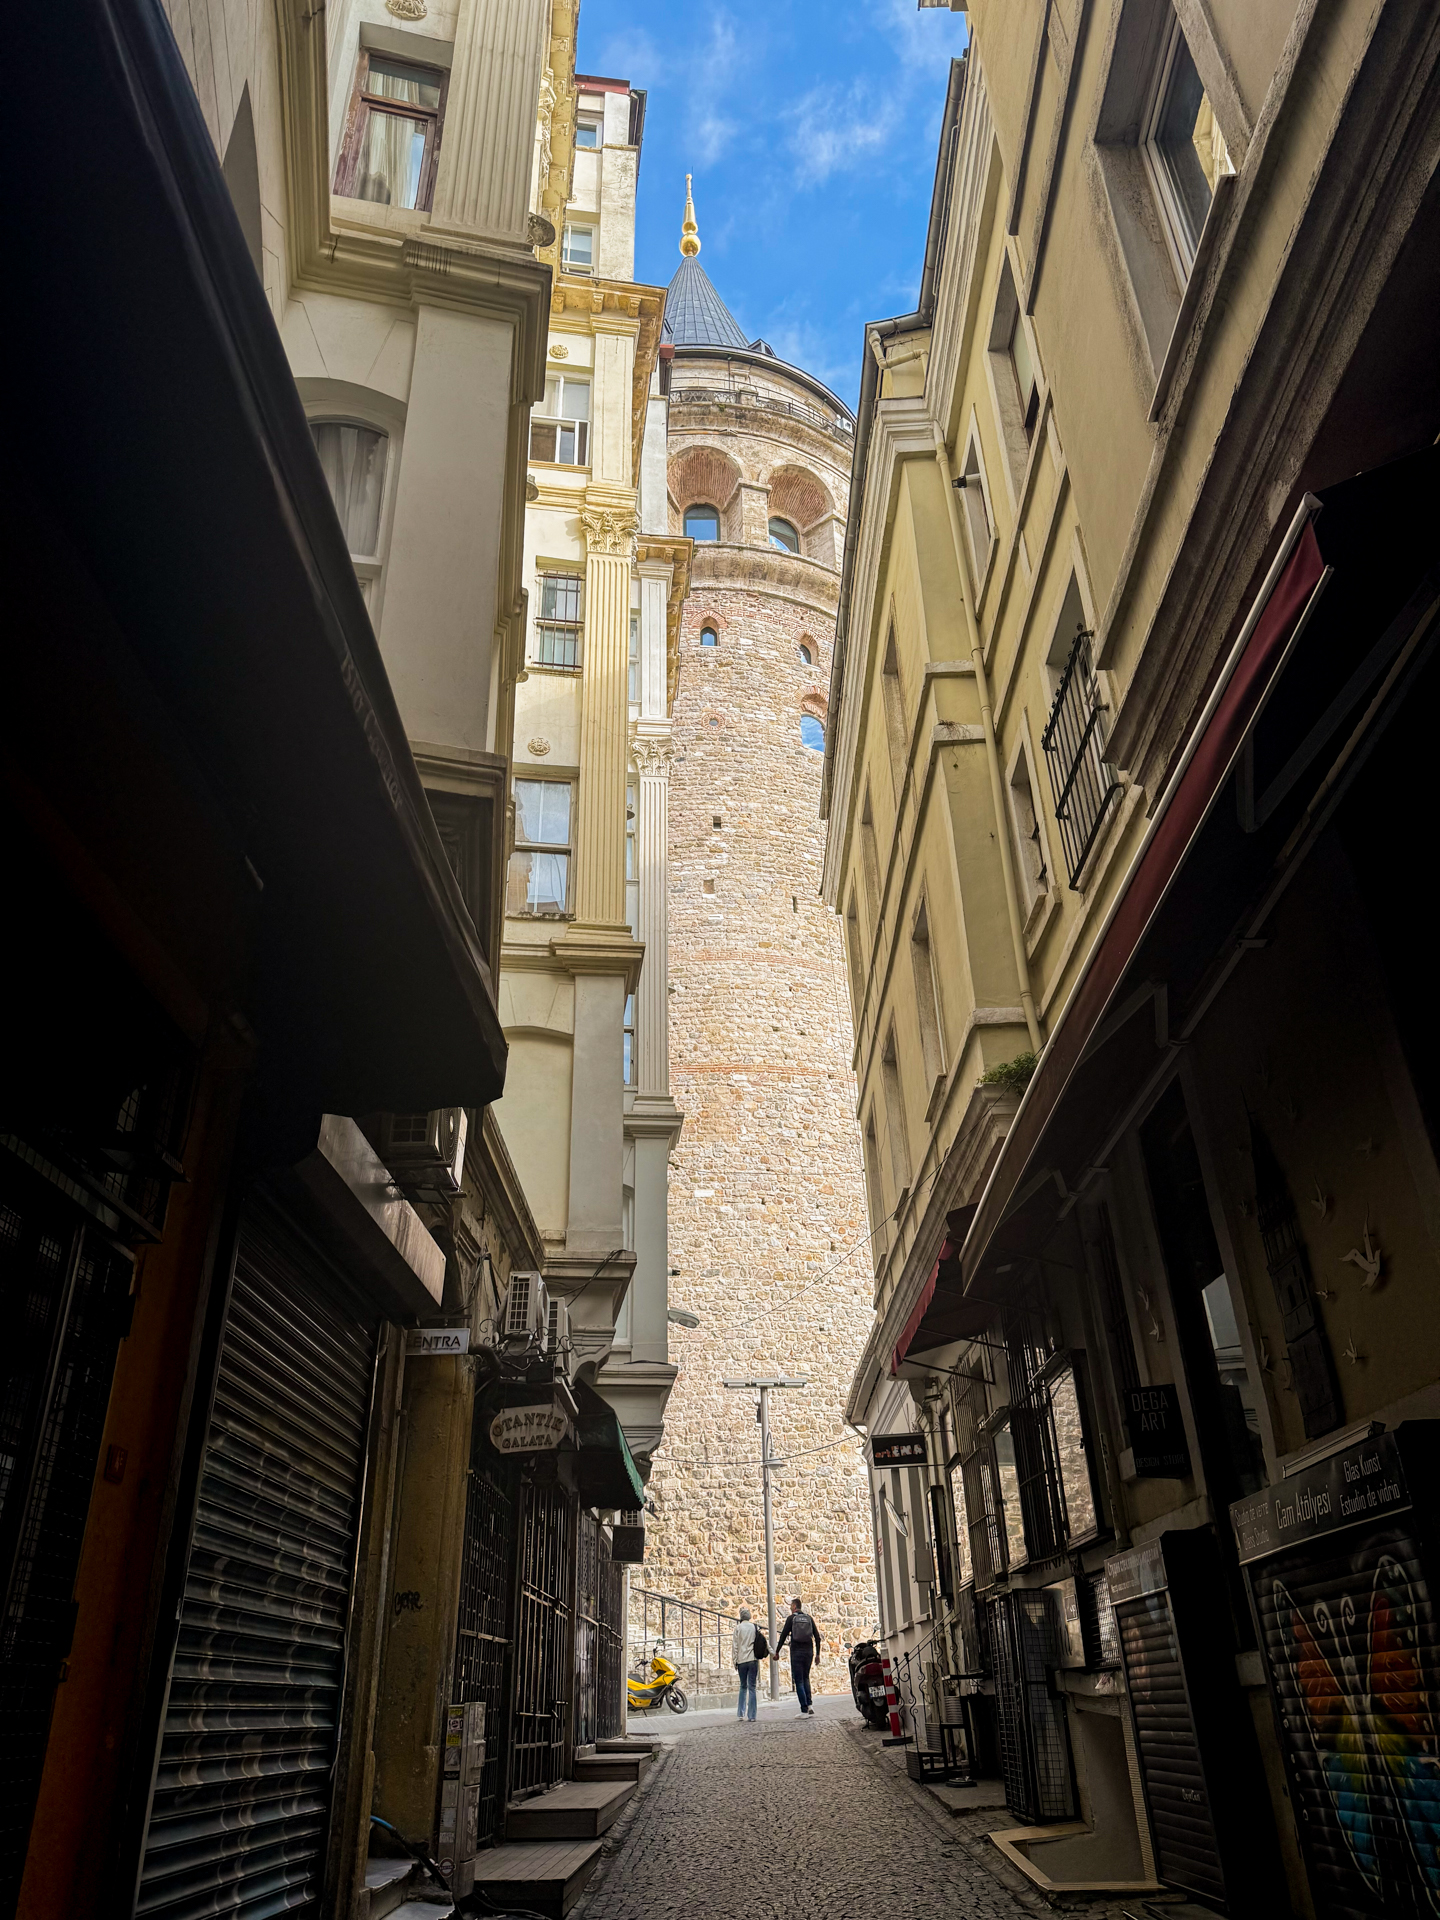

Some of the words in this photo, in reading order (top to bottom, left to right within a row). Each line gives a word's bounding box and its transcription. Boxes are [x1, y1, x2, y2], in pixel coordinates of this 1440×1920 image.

[406, 1335, 461, 1348] ENTRA
[1131, 1390, 1169, 1412] DEGA
[493, 1412, 563, 1437] OTANTİK
[1141, 1410, 1166, 1432] ART
[502, 1434, 553, 1448] GALATA
[1135, 1456, 1160, 1468] DESIGN
[1163, 1453, 1186, 1466] STORE
[1343, 1460, 1361, 1483] Glas
[1359, 1452, 1382, 1477] Kunst
[1275, 1499, 1296, 1530] Cam
[1295, 1484, 1332, 1525] Atölyesi
[1340, 1489, 1367, 1516] Estudio
[1366, 1485, 1378, 1508] de
[1377, 1478, 1401, 1504] vidrio
